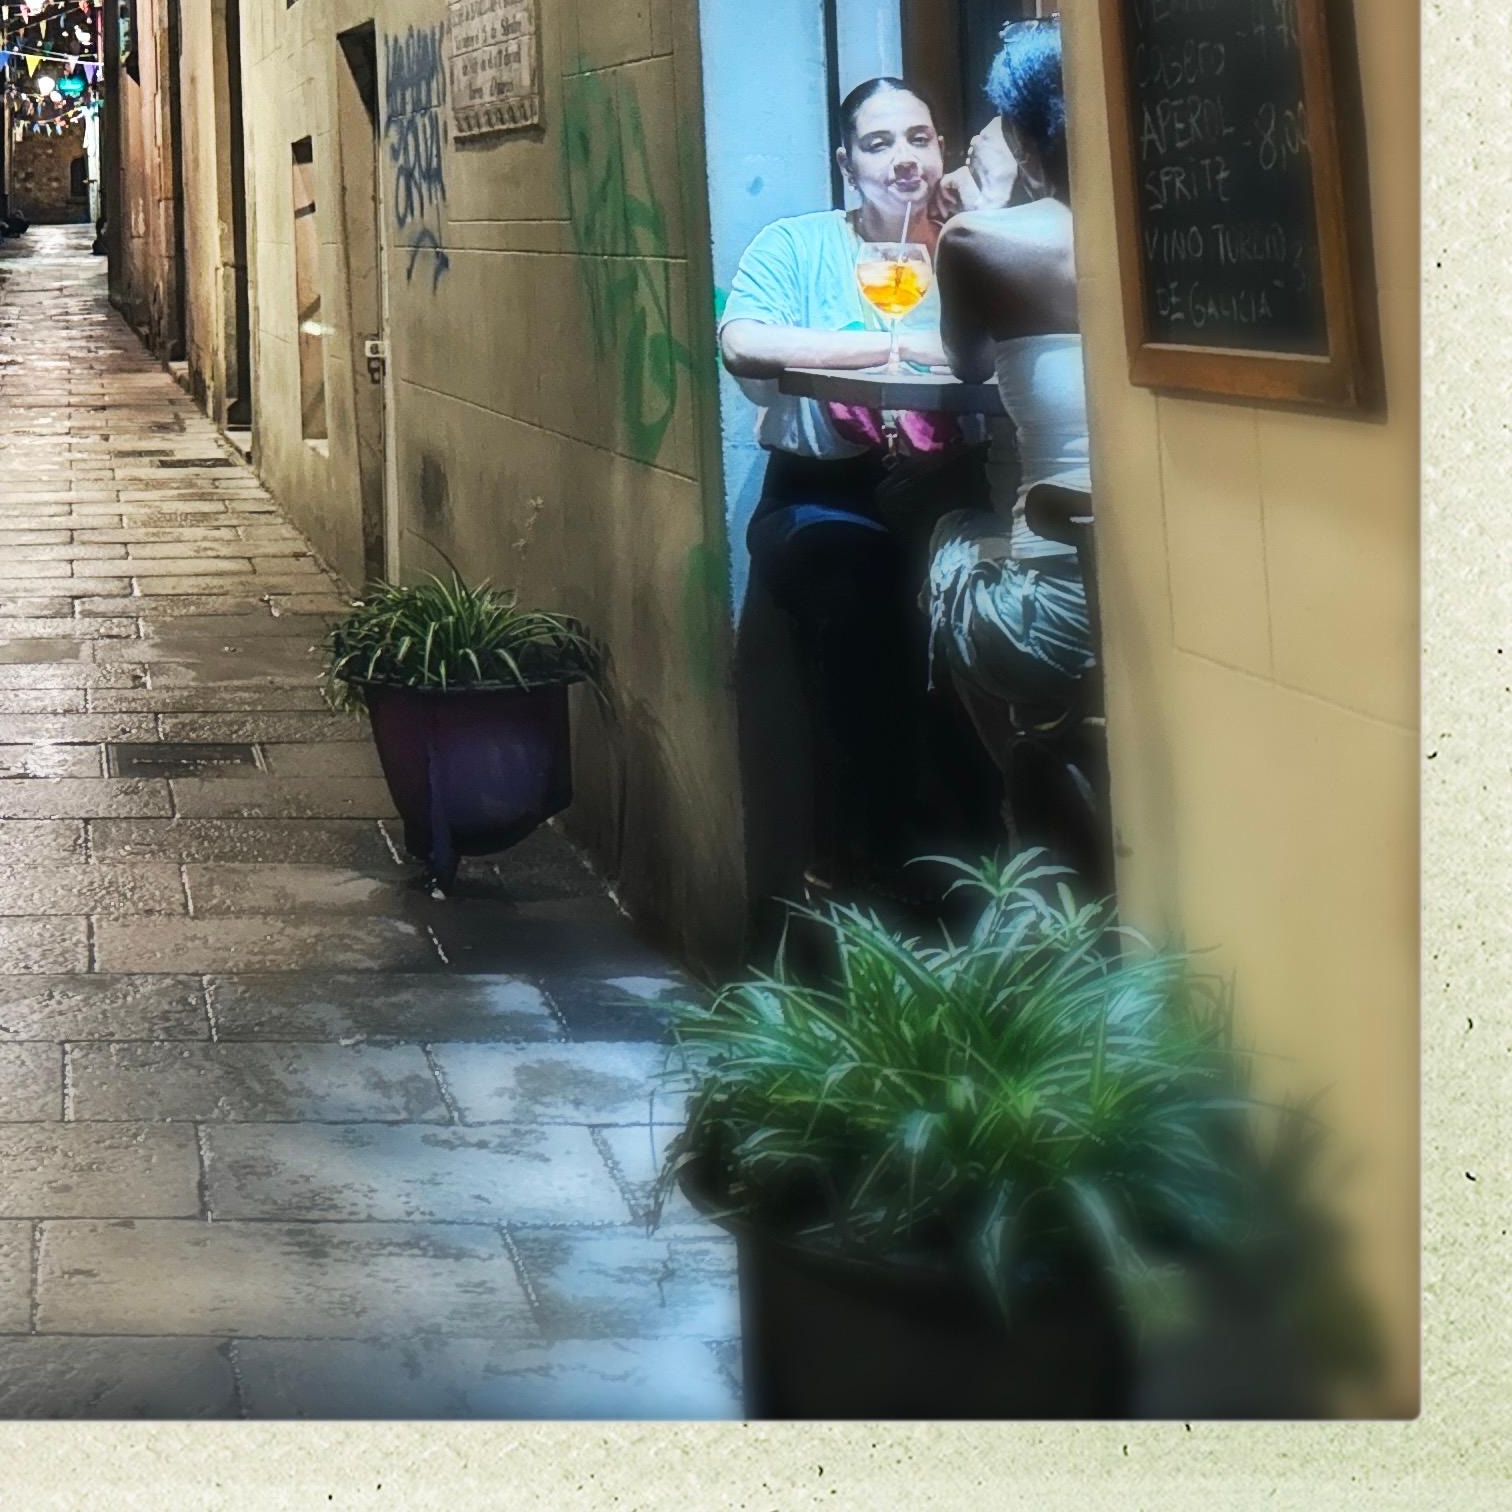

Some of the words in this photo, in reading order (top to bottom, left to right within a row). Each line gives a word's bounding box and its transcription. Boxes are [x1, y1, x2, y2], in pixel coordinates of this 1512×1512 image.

[1140, 95, 1235, 161] APEROL
[1145, 156, 1231, 210] SPRITZ
[1146, 225, 1204, 264] VINO
[1156, 281, 1185, 320] DE
[1190, 281, 1273, 329] GALICIA
